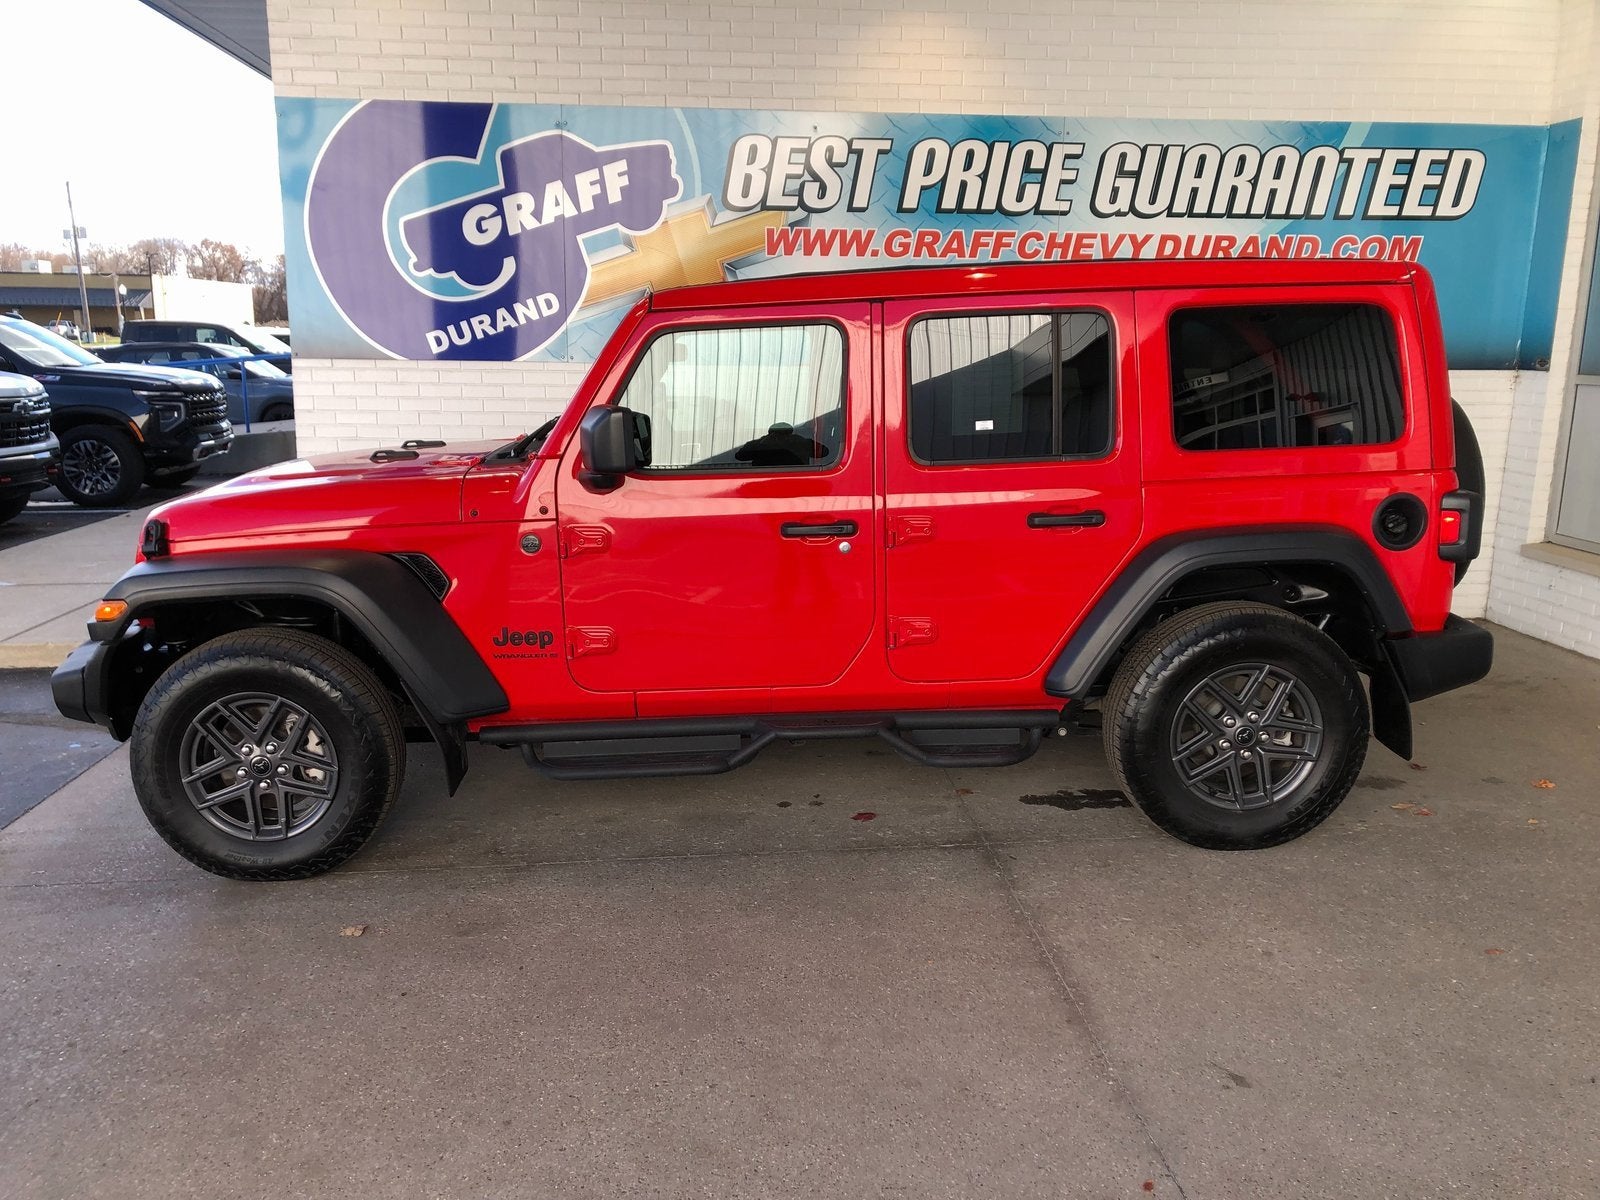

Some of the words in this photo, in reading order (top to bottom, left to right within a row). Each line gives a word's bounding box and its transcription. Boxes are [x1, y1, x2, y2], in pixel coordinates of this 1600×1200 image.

[461, 158, 630, 246] GRAFF
[723, 133, 893, 214] BEST
[897, 137, 1085, 217] PRICE
[1090, 141, 1487, 221] GUARANTEED
[424, 291, 561, 356] DURAND
[492, 626, 554, 649] Jeep
